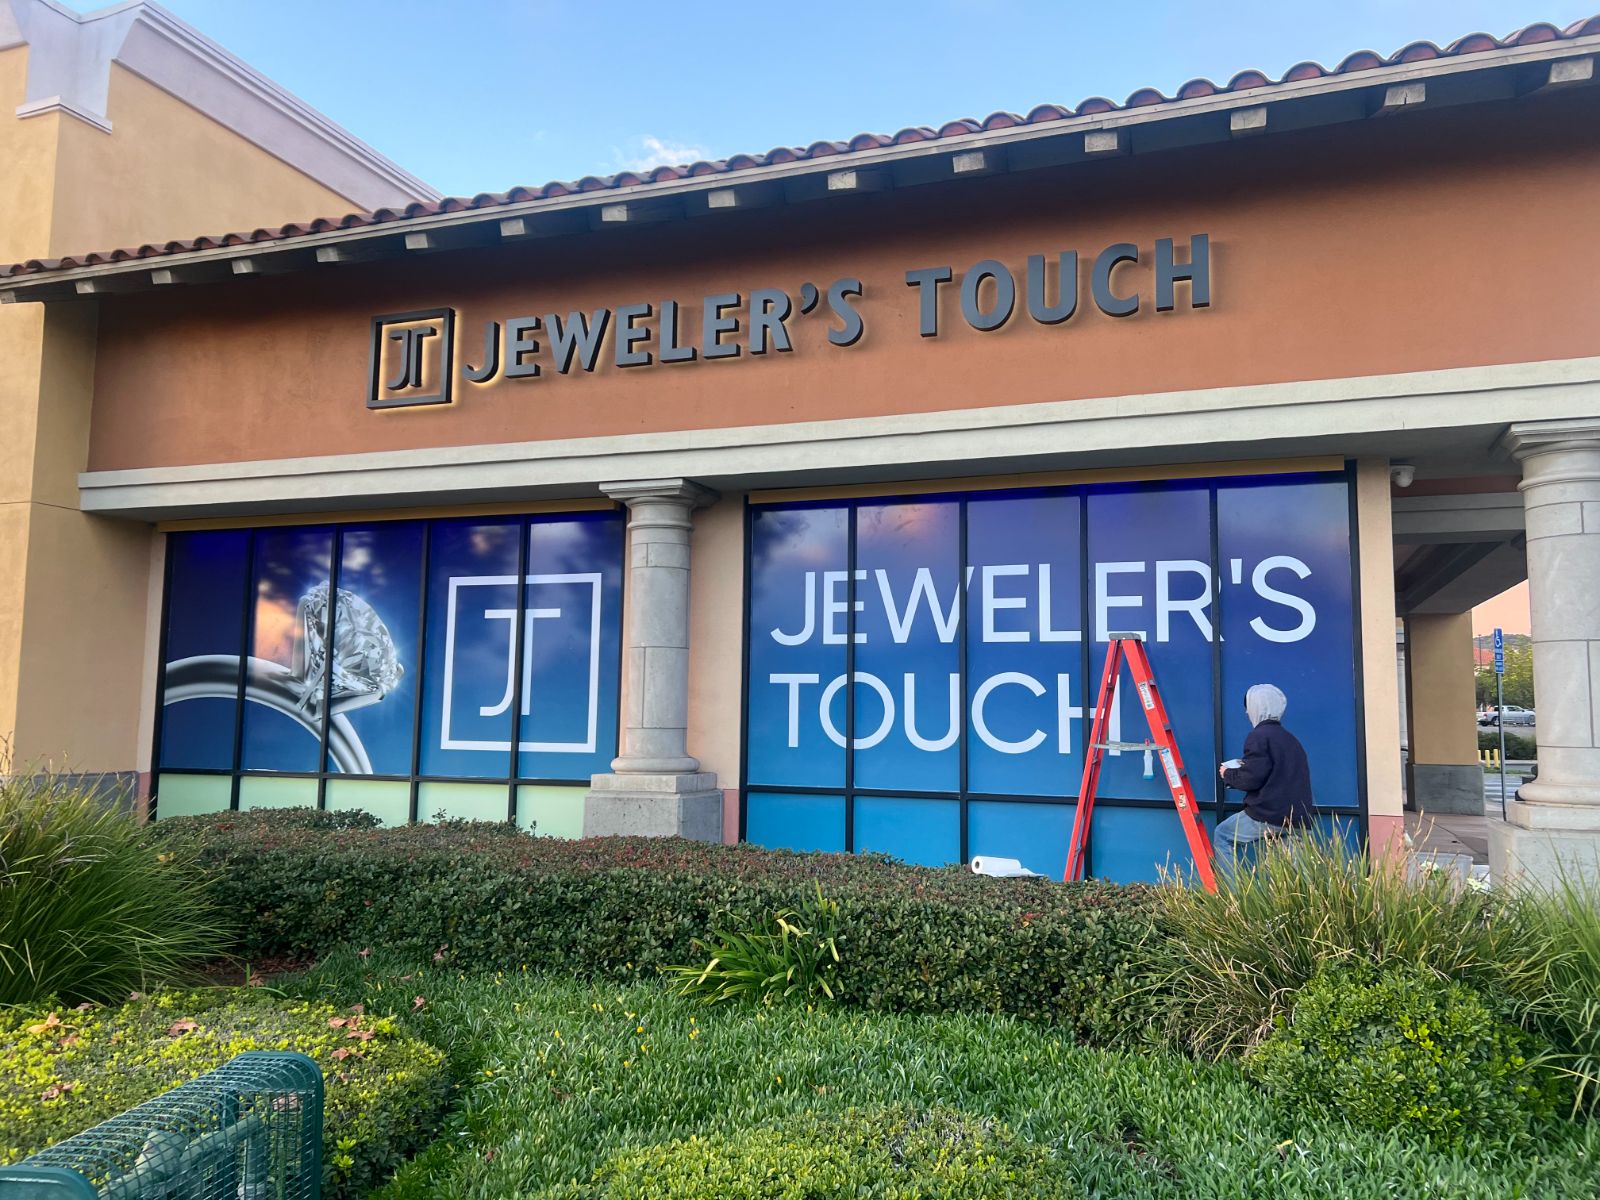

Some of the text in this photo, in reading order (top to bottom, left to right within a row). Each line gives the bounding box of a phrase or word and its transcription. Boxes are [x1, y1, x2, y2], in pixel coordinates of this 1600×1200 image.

[461, 277, 863, 384] JEWELER'S
[905, 233, 1210, 338] TOUCH
[770, 555, 1317, 646] JEWELER'S
[769, 671, 1121, 756] TOUCH
